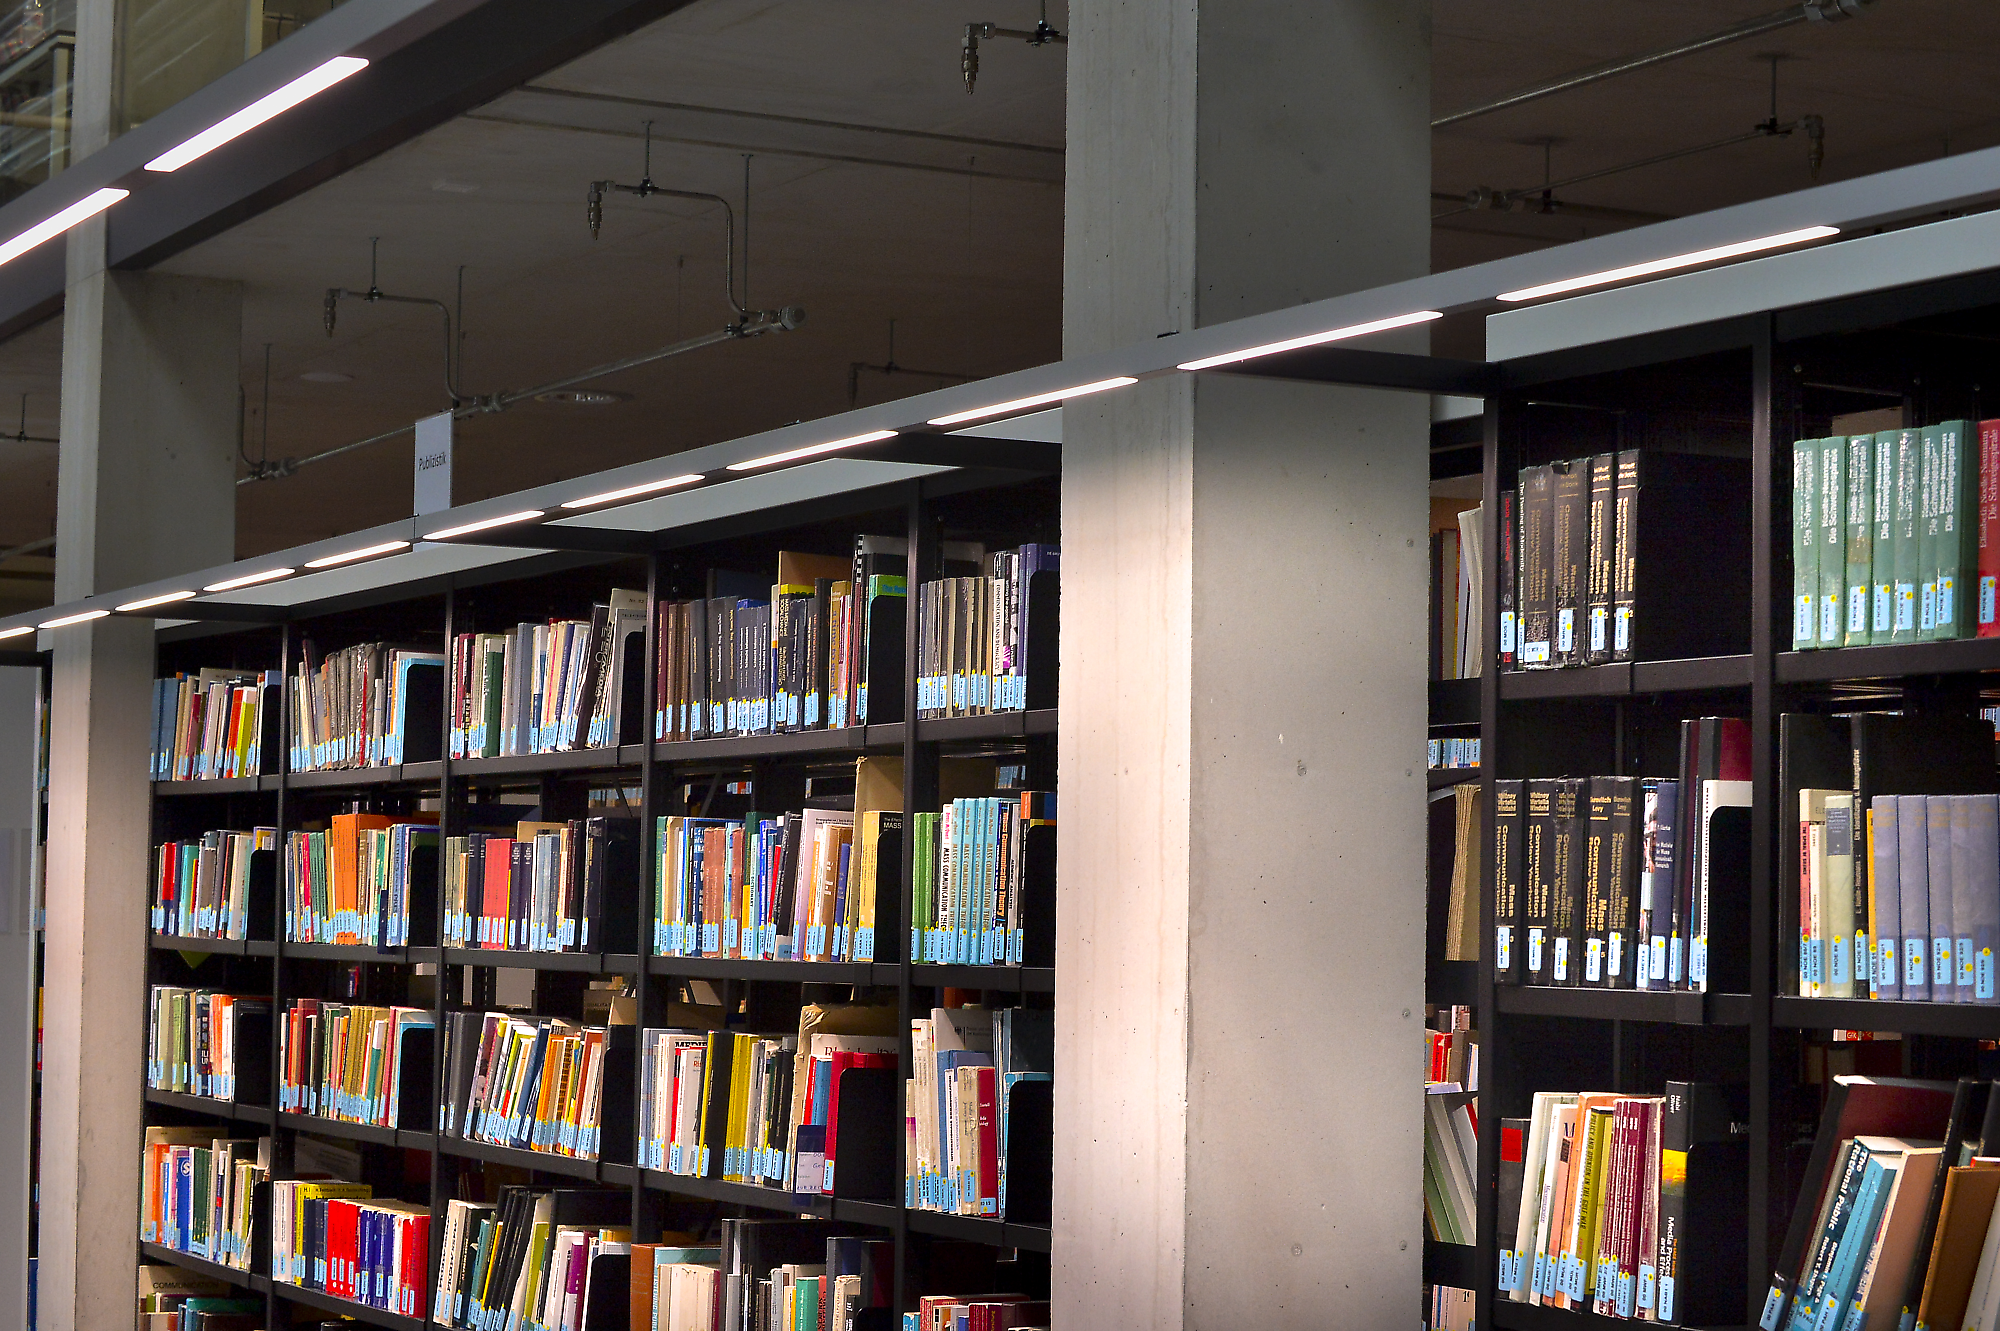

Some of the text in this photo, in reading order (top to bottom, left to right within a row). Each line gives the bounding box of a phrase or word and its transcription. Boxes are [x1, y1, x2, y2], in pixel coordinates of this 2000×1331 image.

[1881, 442, 1891, 539] Die Schweigespirale
[1946, 432, 1956, 531] Die Schweigespirale
[1989, 429, 1999, 519] Die Schweigespirale
[1829, 448, 1839, 544] Die Schweigespirale
[1594, 499, 1603, 595] Communication
[1621, 496, 1629, 592] Communication
[1980, 506, 1988, 548] Elisabeth
[1602, 560, 1610, 594] Mass
[1627, 557, 1635, 592] Mass
[999, 833, 1008, 890] Communication
[1500, 824, 1508, 917] Communication
[1533, 824, 1541, 918] Communication
[1590, 835, 1600, 930] Communication
[940, 865, 949, 912] COMMUNICATION
[949, 860, 958, 907] COMMUNICATION
[961, 860, 970, 908] COMMUNICATION
[984, 860, 993, 908] COMMUNICATION
[997, 890, 1006, 917] Theory
[1597, 898, 1607, 931] Mass
[1587, 1136, 1595, 1150] AND
[1588, 1114, 1597, 1136] POLICY
[1585, 1151, 1593, 1176] OPINION
[1840, 1143, 1861, 1195] Rational
[1856, 1150, 1867, 1172] The
[1580, 1215, 1588, 1230] WAR
[1666, 1216, 1675, 1245] Media
[1828, 1195, 1845, 1230] Public
[1659, 1237, 1667, 1254] and
[1819, 1236, 1830, 1261] Robert
[1824, 1242, 1838, 1272] Benjamin
[1806, 1267, 1820, 1297] Shapiro
